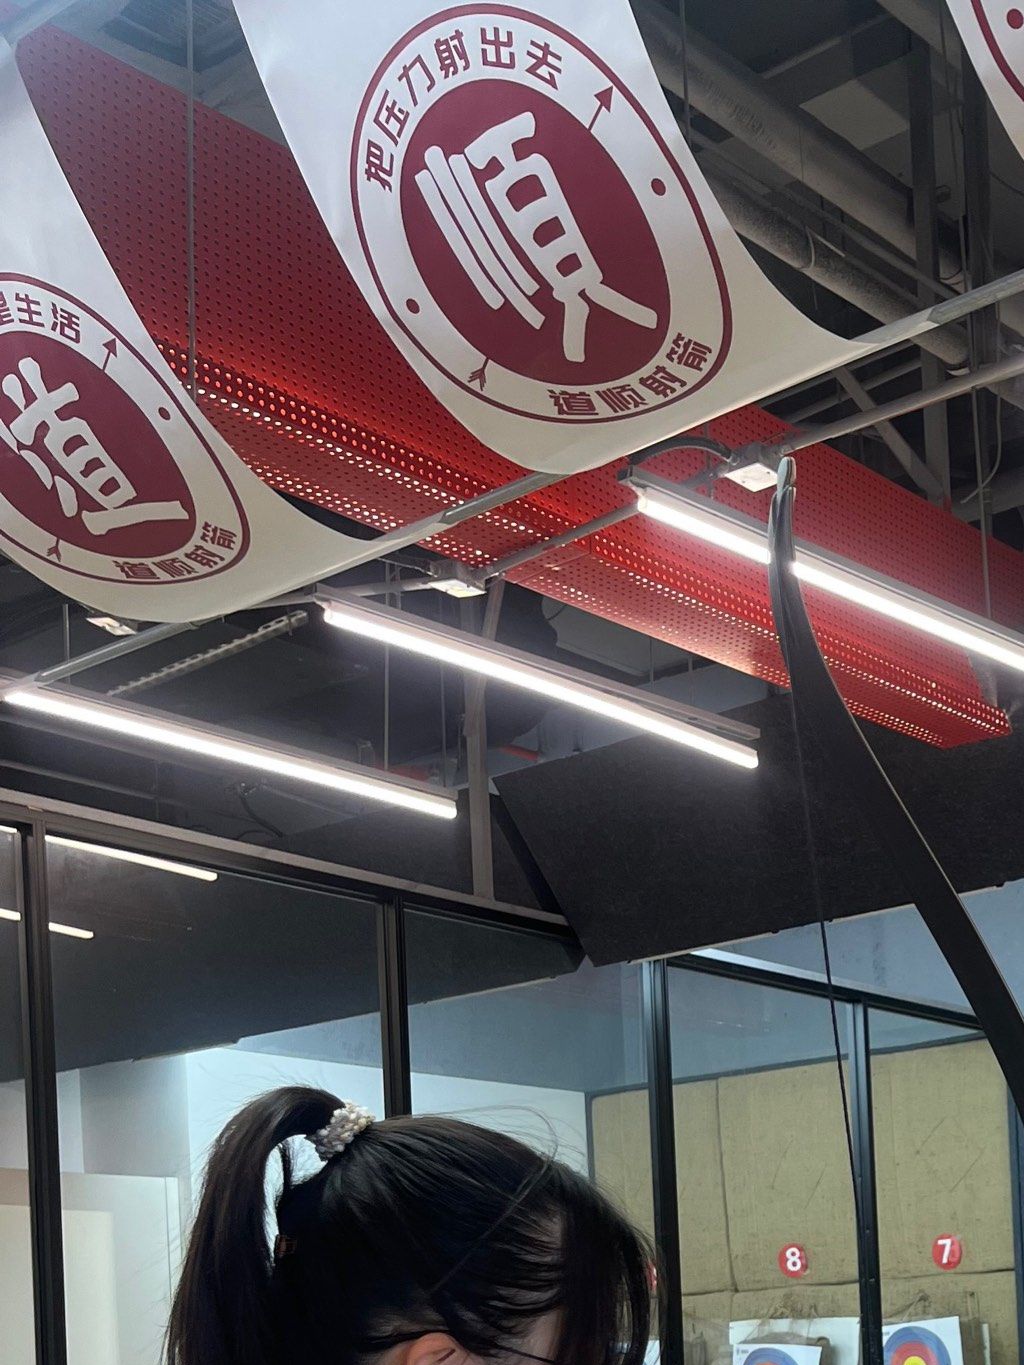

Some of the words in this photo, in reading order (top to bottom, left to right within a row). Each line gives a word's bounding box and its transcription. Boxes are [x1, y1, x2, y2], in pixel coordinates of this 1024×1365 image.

[364, 26, 563, 194] 把压力射出去
[549, 332, 712, 416] 道顺射箭
[113, 521, 238, 580] 道顺射箭
[785, 1246, 802, 1272] 8
[936, 1238, 954, 1264] 7
